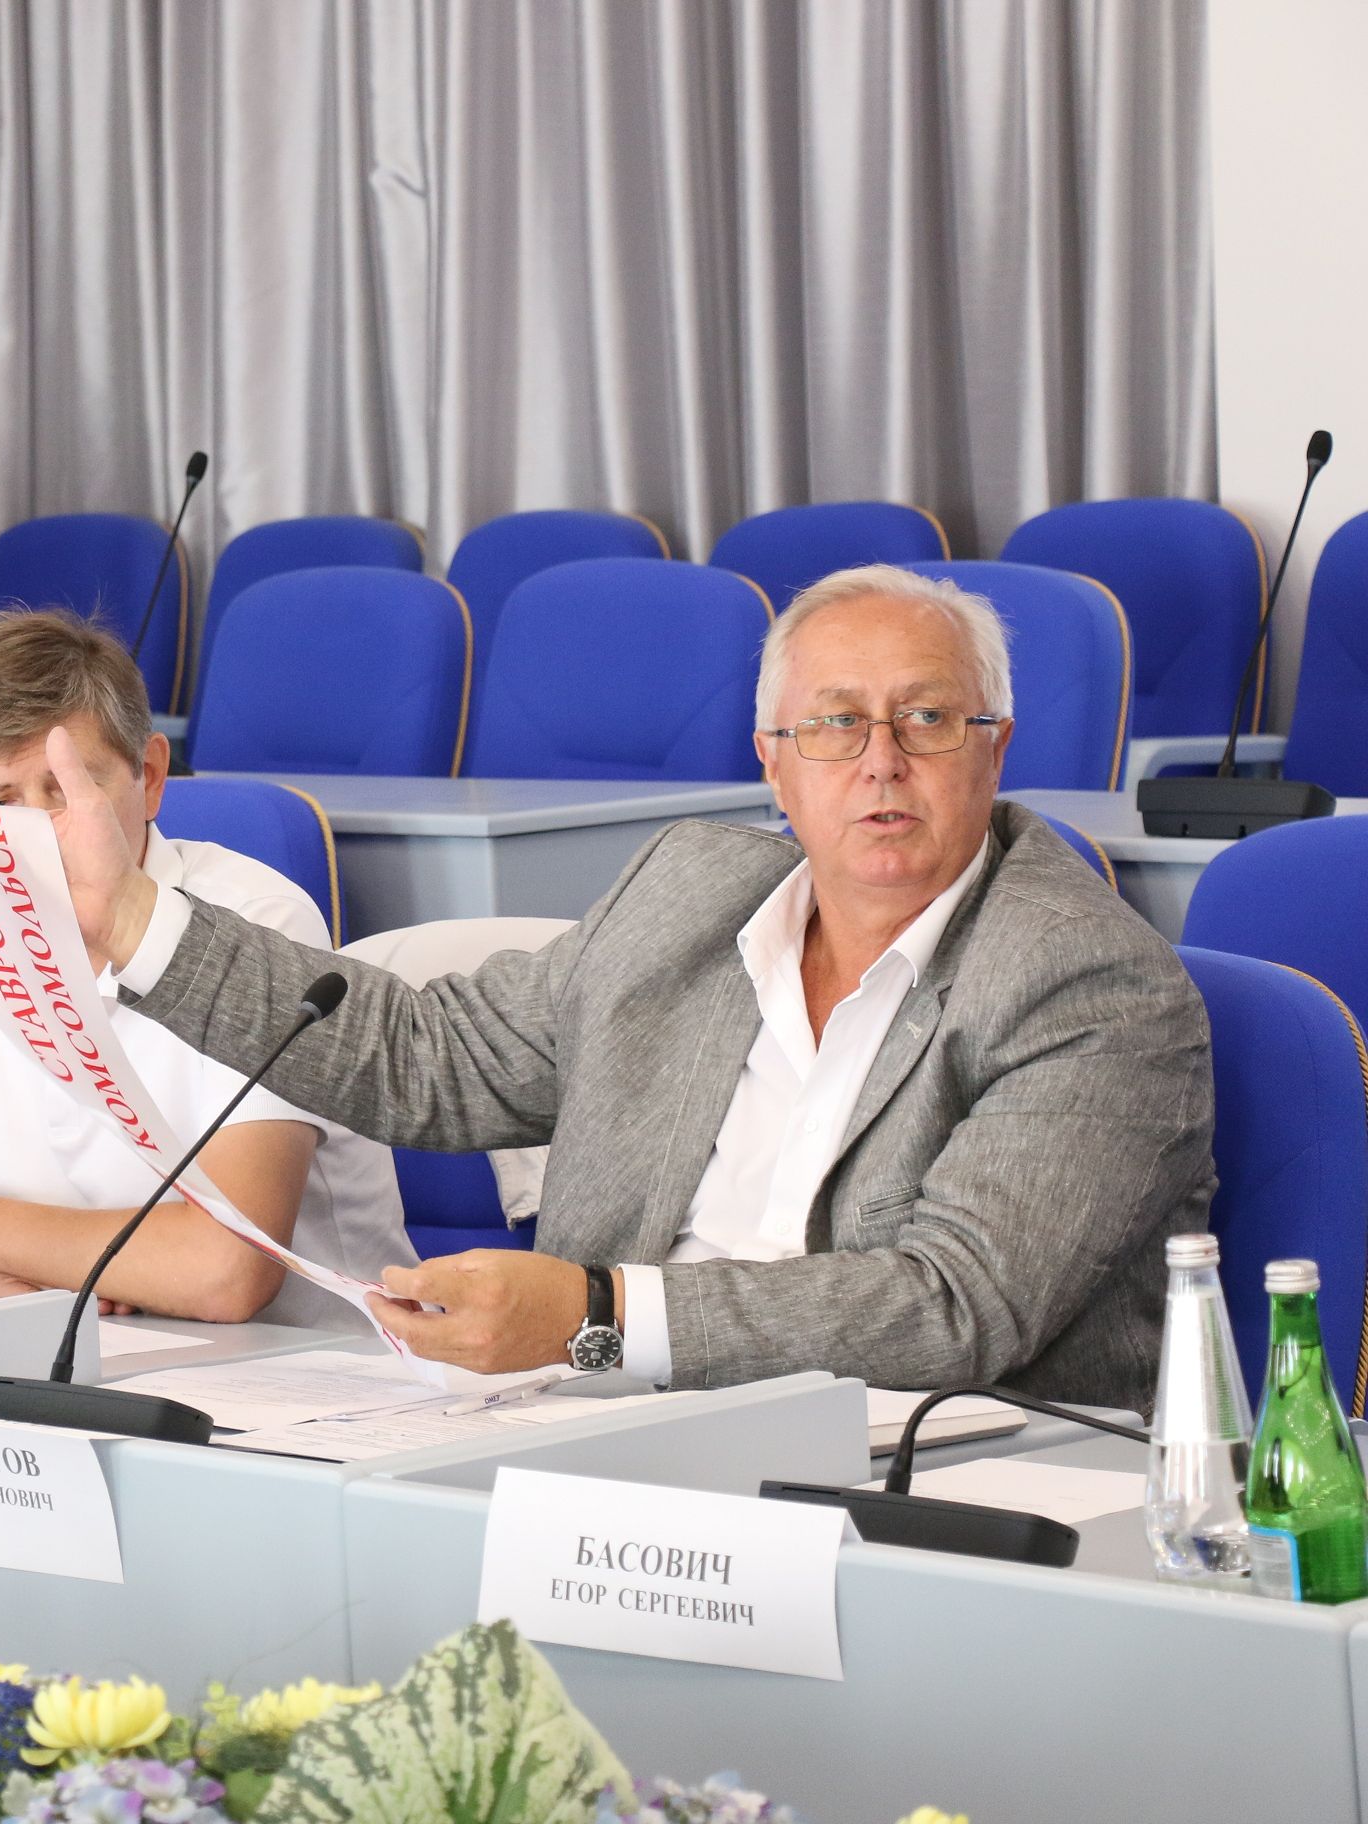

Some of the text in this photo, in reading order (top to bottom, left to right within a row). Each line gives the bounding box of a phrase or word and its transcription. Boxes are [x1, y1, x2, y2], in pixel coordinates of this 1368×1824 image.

[576, 1536, 731, 1585] БАСОВИЧ
[550, 1578, 754, 1626] ЕГОР СЕРГЕЕВИЧ
